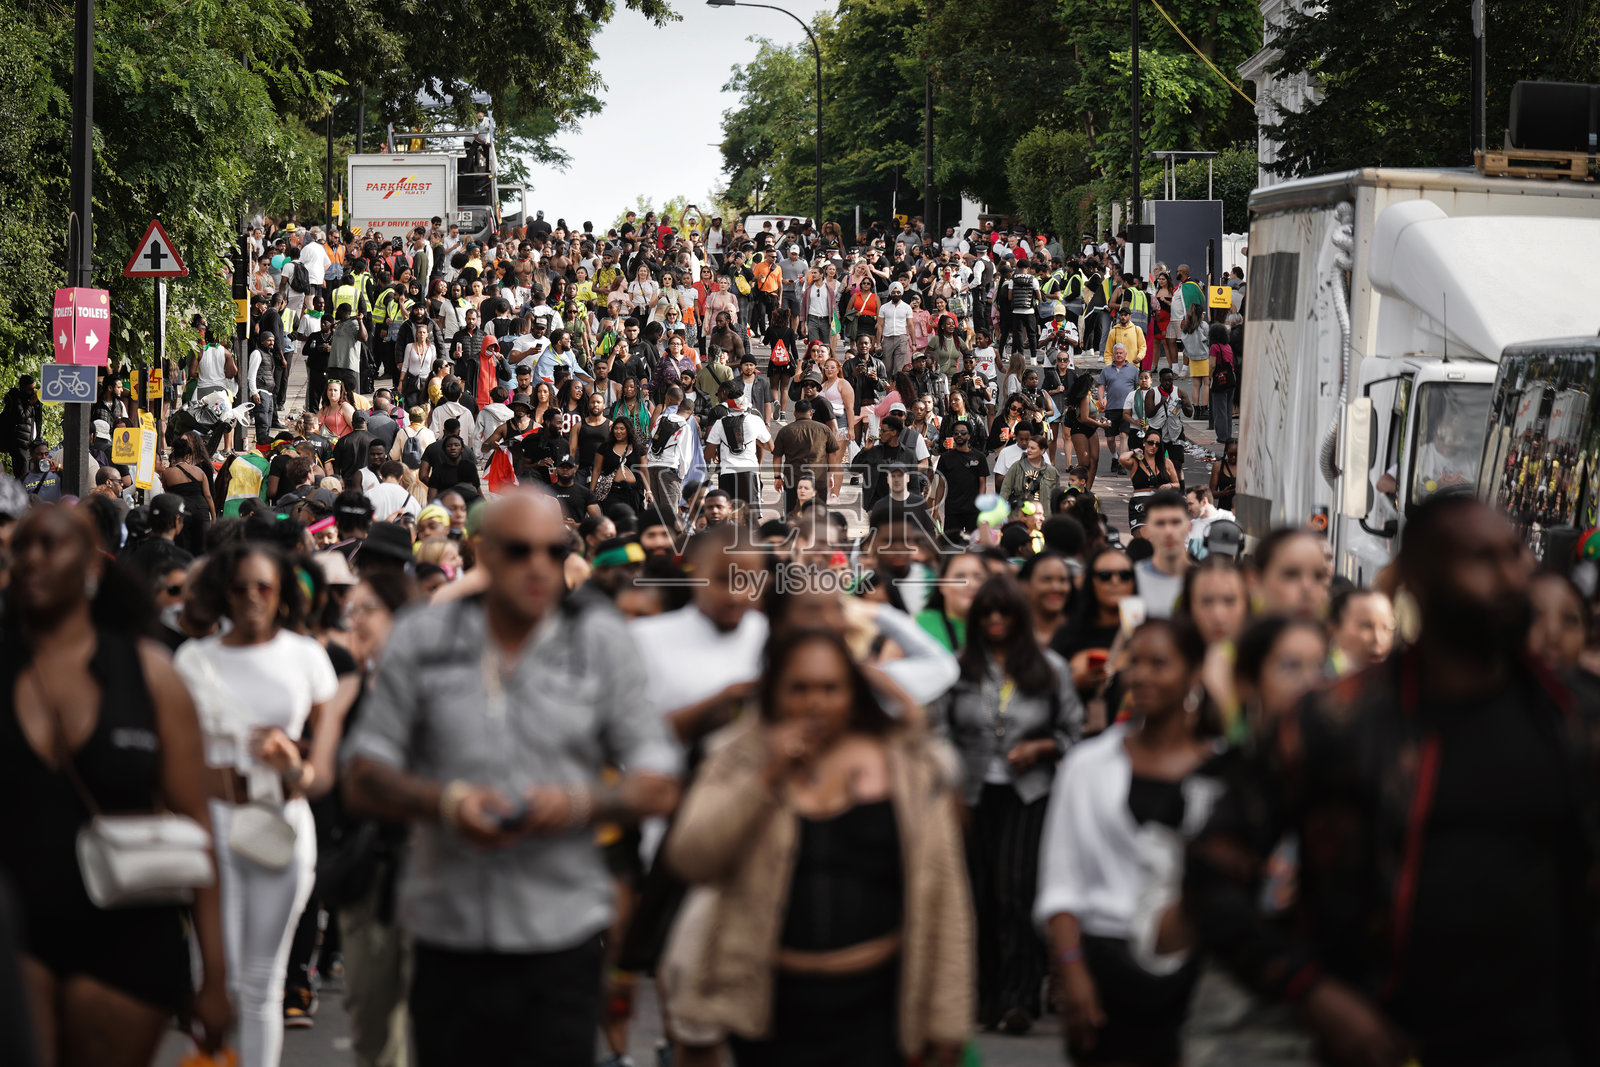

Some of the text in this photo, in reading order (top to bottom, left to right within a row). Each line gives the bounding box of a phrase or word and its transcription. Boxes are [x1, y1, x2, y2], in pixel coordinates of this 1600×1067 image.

[366, 182, 432, 191] PARKHURST
[54, 306, 73, 318] TOILETS
[78, 306, 109, 319] TOILETS
